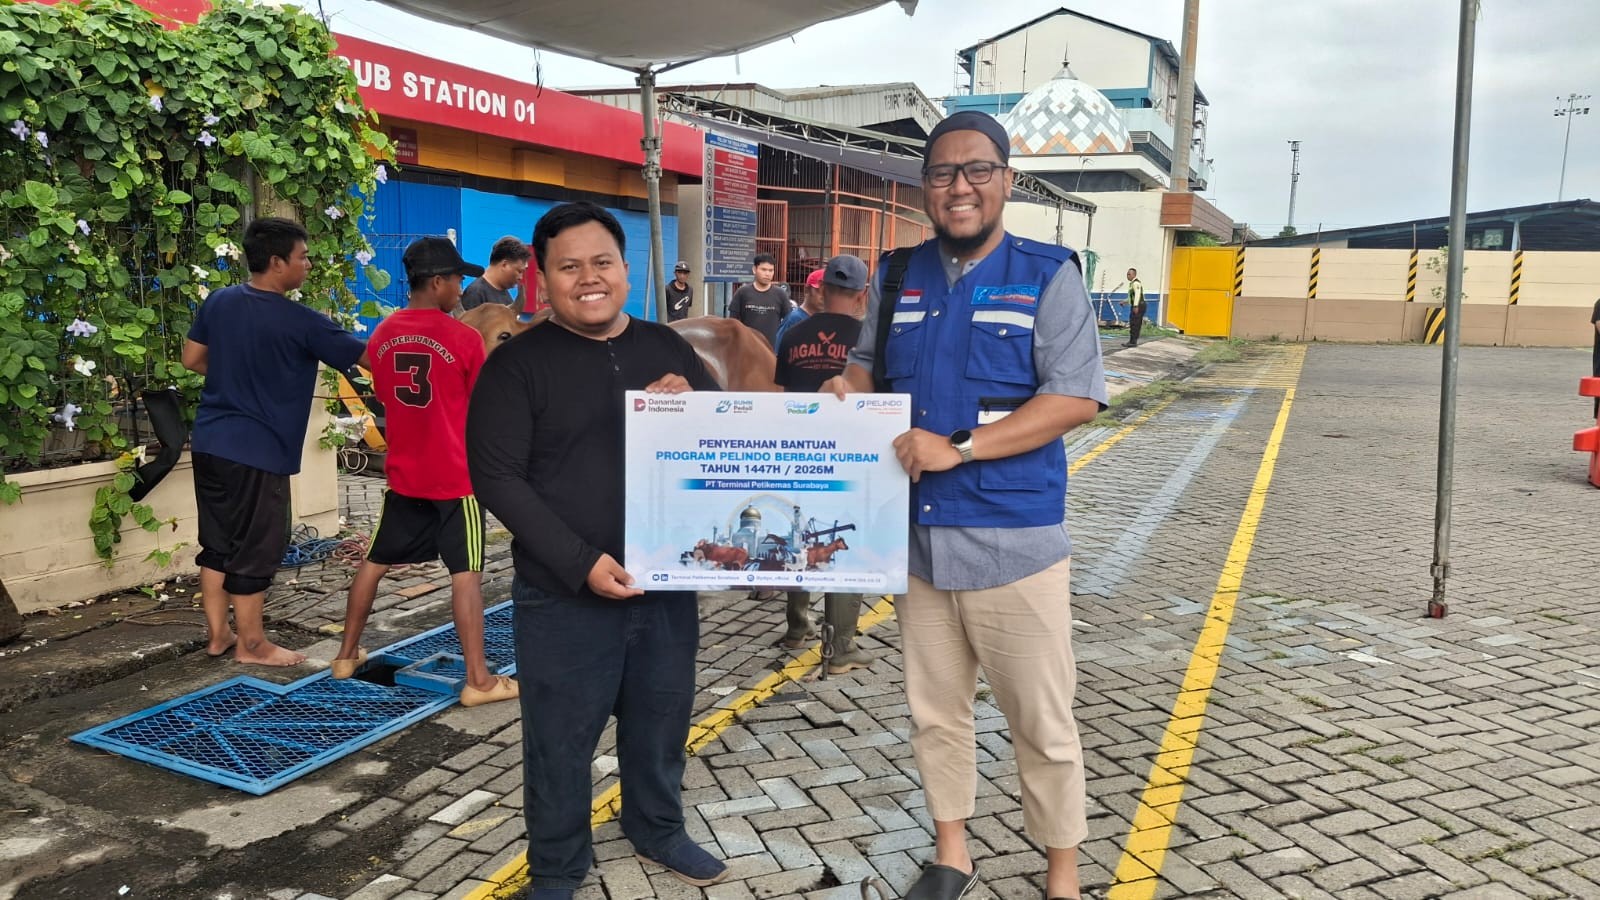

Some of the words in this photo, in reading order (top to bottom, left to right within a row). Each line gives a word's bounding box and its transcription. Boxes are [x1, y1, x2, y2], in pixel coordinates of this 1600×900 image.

[403, 71, 506, 118] STATION
[514, 99, 535, 125] 01
[391, 335, 455, 363] PERJUANGAN
[394, 352, 432, 408] 3
[699, 439, 777, 449] PENYERAHAN
[781, 440, 836, 450] BANTUAN
[656, 451, 716, 461] PROGRAM
[720, 452, 771, 461] PELINDO
[775, 452, 826, 462] BERBAGI
[830, 454, 879, 463] KURBAN
[701, 464, 740, 474] TAHUN
[745, 464, 781, 474] 1447H
[784, 465, 791, 476] /
[794, 465, 834, 474] 2026M
[752, 481, 792, 489] Petikemas
[793, 482, 829, 490] Surabaya
